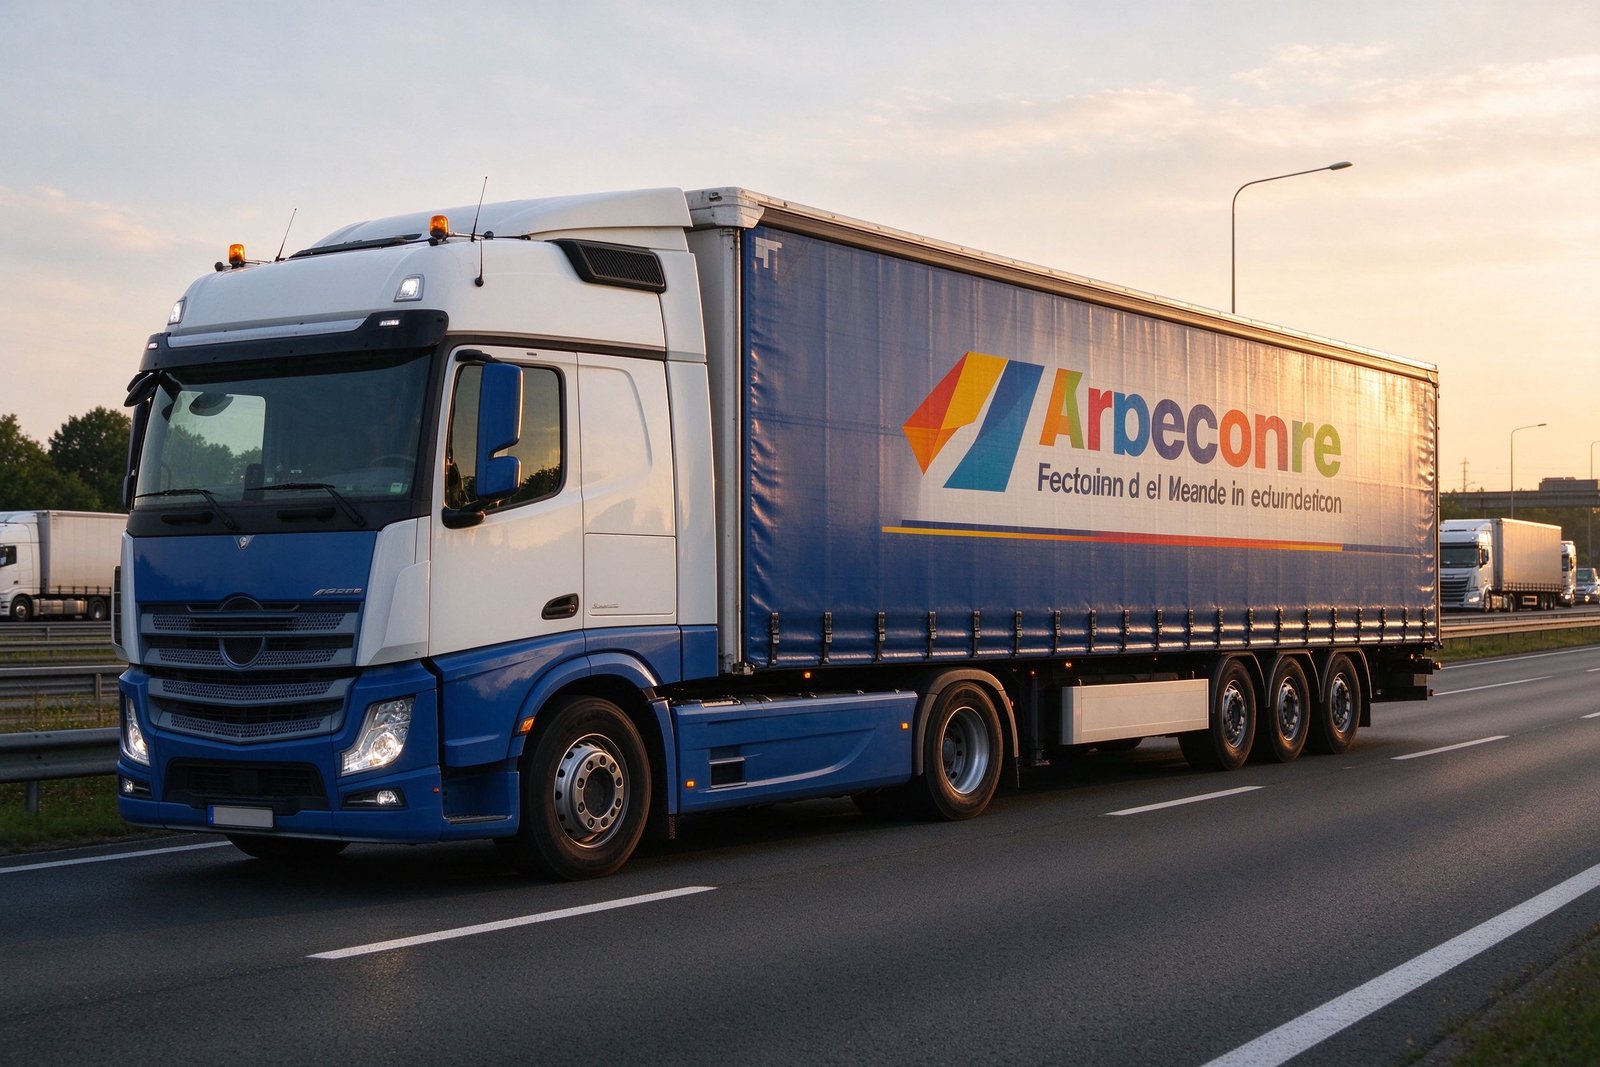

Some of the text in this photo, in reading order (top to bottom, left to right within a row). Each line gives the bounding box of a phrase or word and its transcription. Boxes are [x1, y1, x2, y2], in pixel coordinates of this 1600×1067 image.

[1039, 367, 1342, 478] Arpeconre
[1129, 471, 1140, 499] d
[1146, 473, 1161, 500] el
[1168, 475, 1227, 505] Meande
[1231, 480, 1245, 506] in
